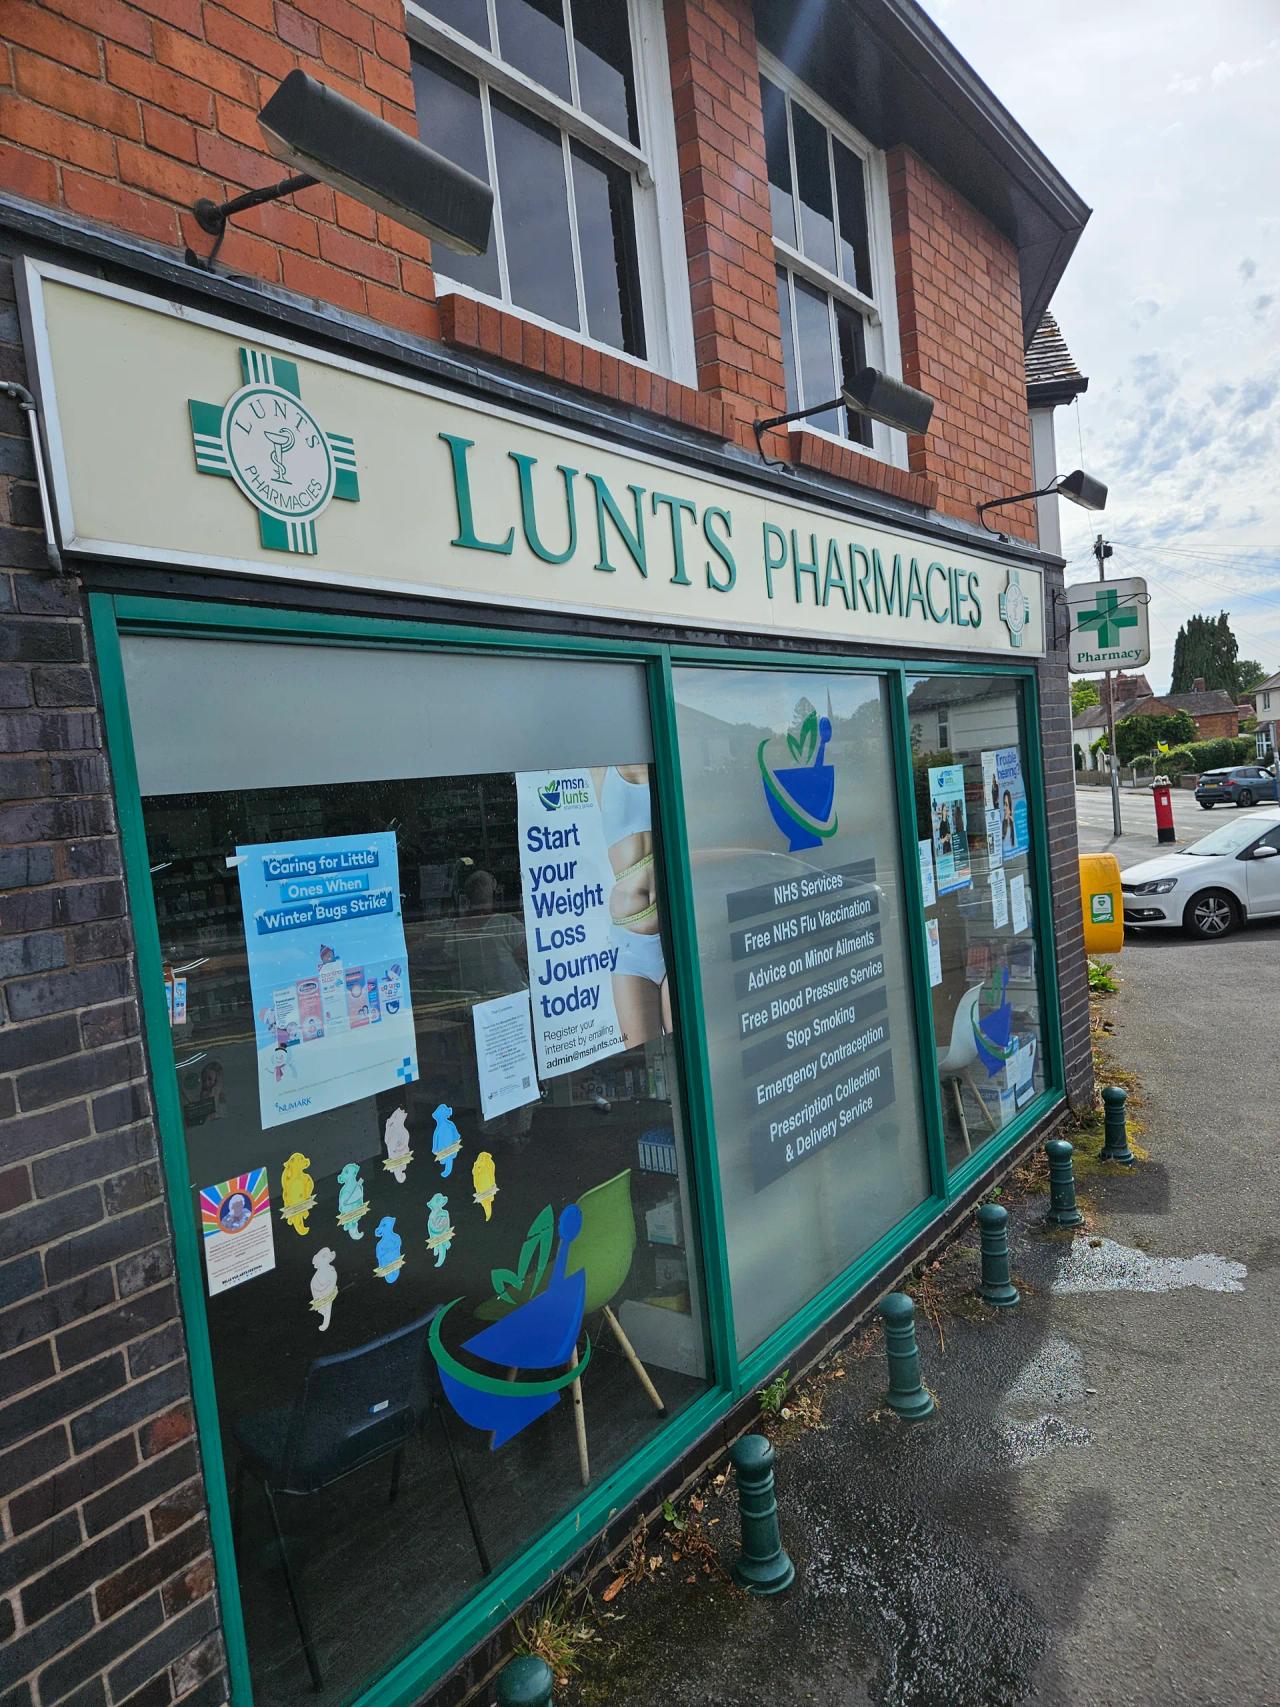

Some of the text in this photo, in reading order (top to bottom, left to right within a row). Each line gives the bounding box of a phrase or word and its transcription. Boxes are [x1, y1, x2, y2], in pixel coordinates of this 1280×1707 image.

[235, 399, 320, 448] LUNTS
[245, 465, 322, 510] PHARMACIES
[439, 432, 982, 628] LUNTS PHARMACIES
[1078, 649, 1142, 662] Pharmacy
[561, 778, 584, 790] msn
[562, 790, 588, 804] lunts
[527, 824, 580, 852] Start
[269, 852, 374, 874] Caring for Little
[529, 860, 577, 892] your
[288, 879, 362, 898] Ones When
[532, 884, 603, 918] Weight
[774, 874, 843, 904] NHS Services
[265, 896, 386, 928] Winter Bugs Strike
[745, 900, 871, 952] Free NHS Flu Vaccination
[536, 924, 586, 952] Loss
[539, 948, 619, 985] Journey
[748, 931, 874, 991] Advice on Minor Ailments
[541, 985, 600, 1018] today
[742, 961, 883, 1032] Free Blood Pressure Service
[544, 1019, 594, 1042] Register your
[545, 1025, 614, 1055] interest by emailing
[786, 1005, 855, 1050] Stop Smoking
[757, 1026, 883, 1105] Emergency Contraception
[279, 1097, 312, 1112] NUMARK
[770, 1065, 880, 1142] Prescription Collection
[786, 1096, 873, 1162] & Delivery Service
